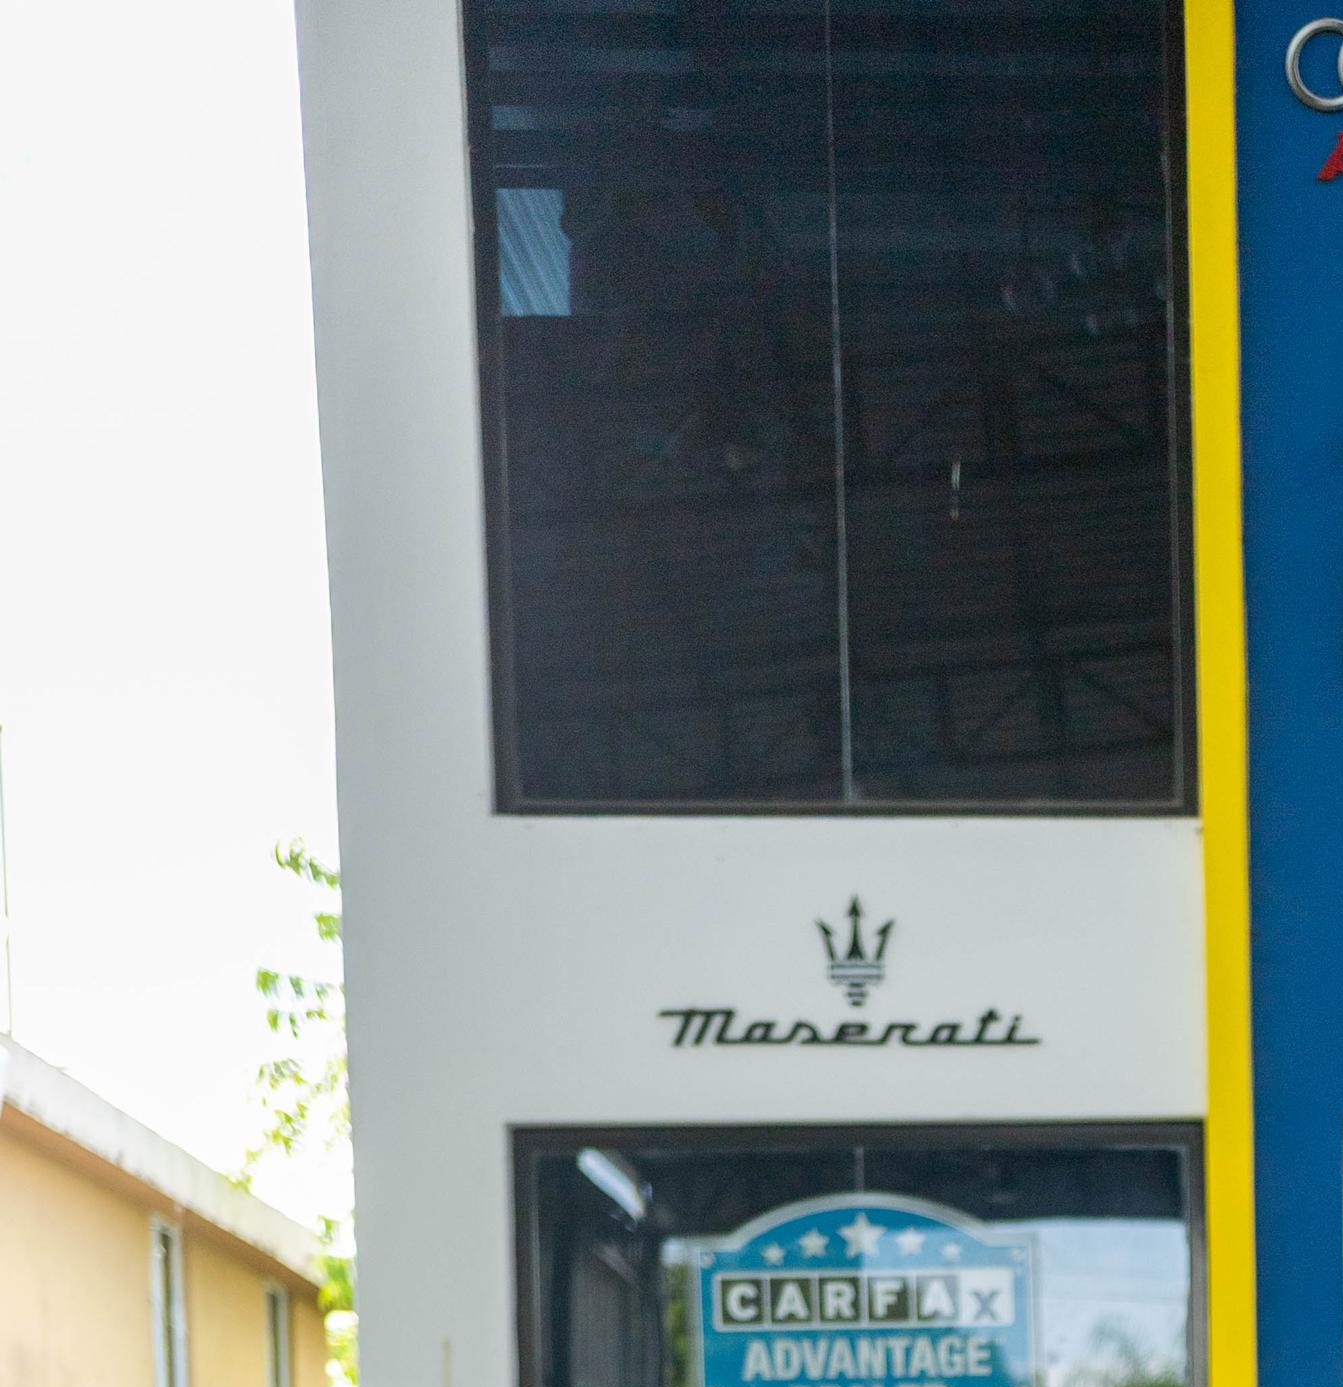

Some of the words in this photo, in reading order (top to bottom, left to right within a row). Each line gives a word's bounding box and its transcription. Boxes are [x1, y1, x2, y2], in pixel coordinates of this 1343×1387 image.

[658, 1008, 1042, 1048] Maserati
[722, 1277, 1002, 1324] CARFAX
[742, 1336, 994, 1382] ADVANTAGE
